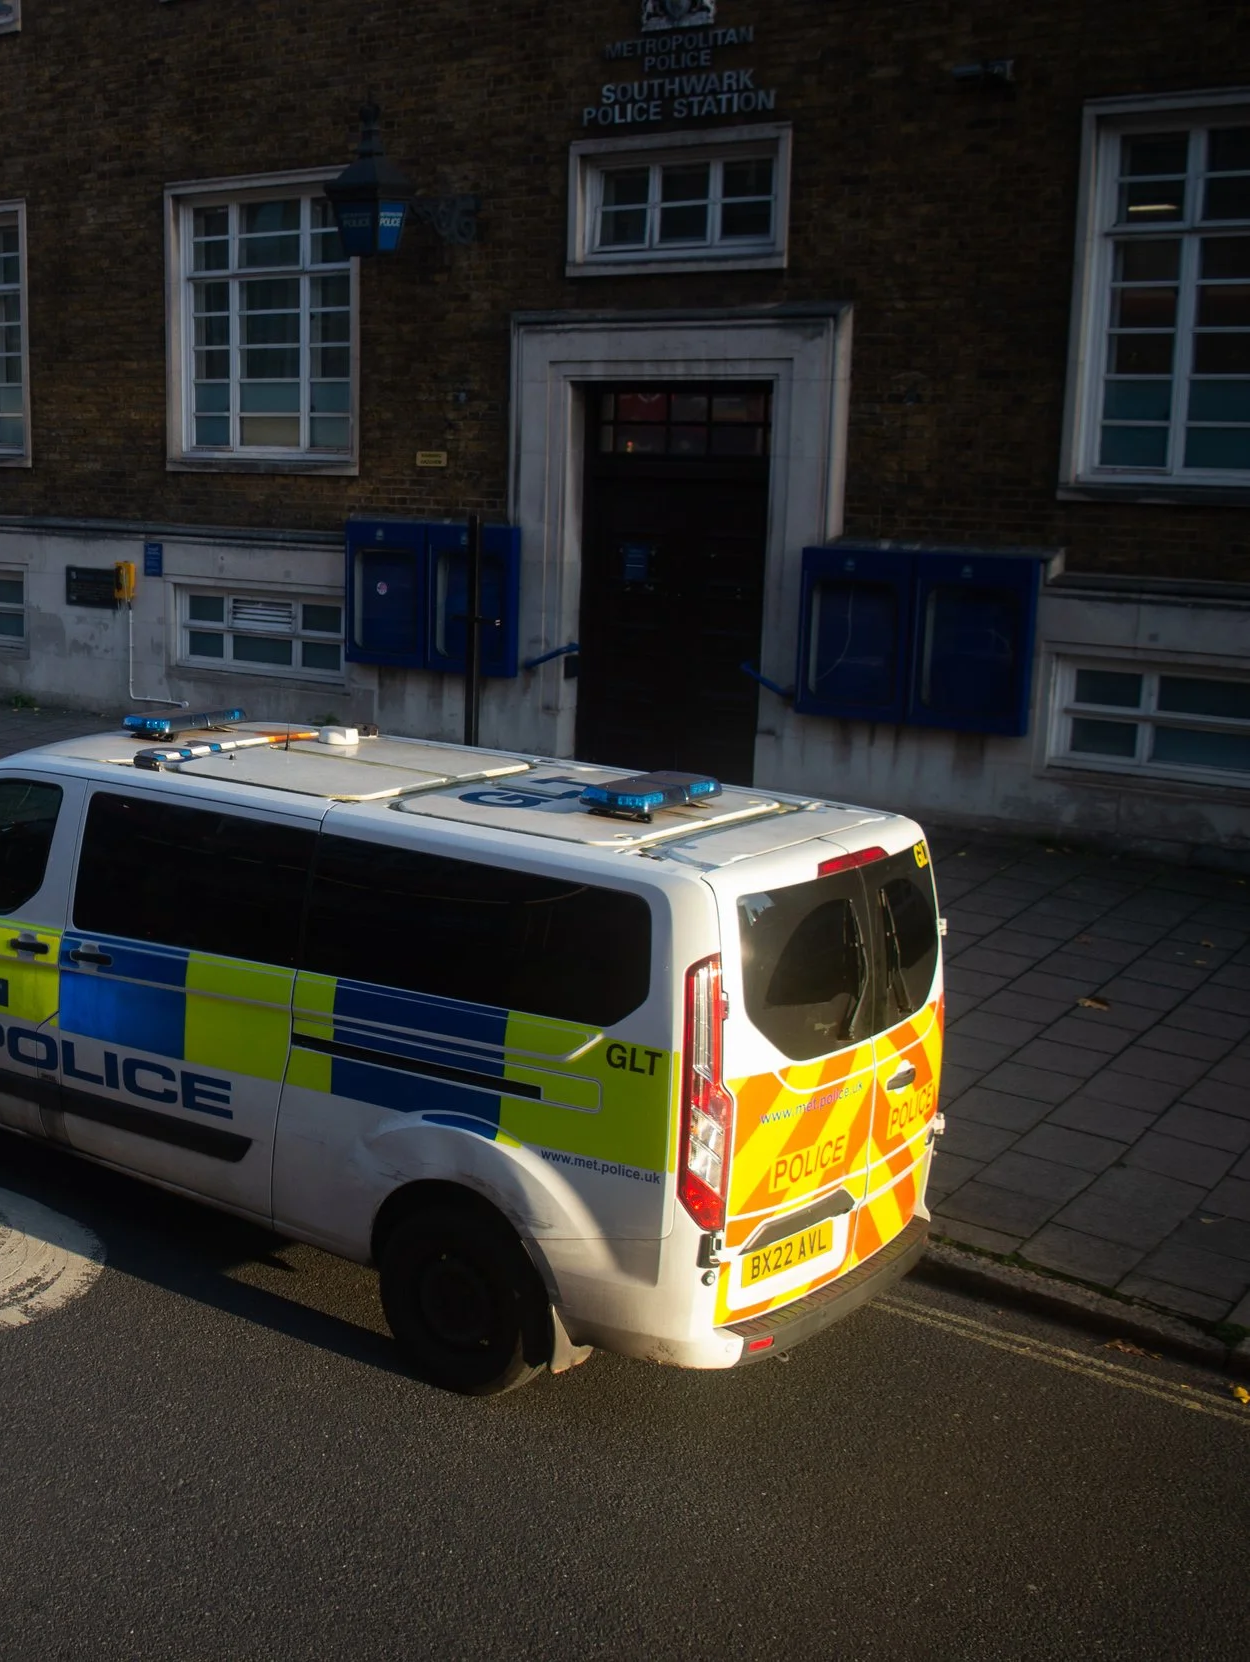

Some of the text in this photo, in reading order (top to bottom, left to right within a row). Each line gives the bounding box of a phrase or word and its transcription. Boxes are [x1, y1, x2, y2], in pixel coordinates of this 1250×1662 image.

[605, 25, 754, 60] METROPOLITAN
[643, 50, 711, 72] POLICE
[601, 68, 754, 104] SOUTHWARK
[582, 88, 777, 126] POLICE STATION
[379, 217, 401, 227] POLICE
[606, 1043, 663, 1076] GLT
[759, 1082, 864, 1124] www.met.police.uk
[889, 1082, 934, 1136] POLICE
[541, 1149, 661, 1185] www.met.police.uk
[773, 1135, 846, 1189] POLICE
[751, 1229, 827, 1281] BX22 AVL
